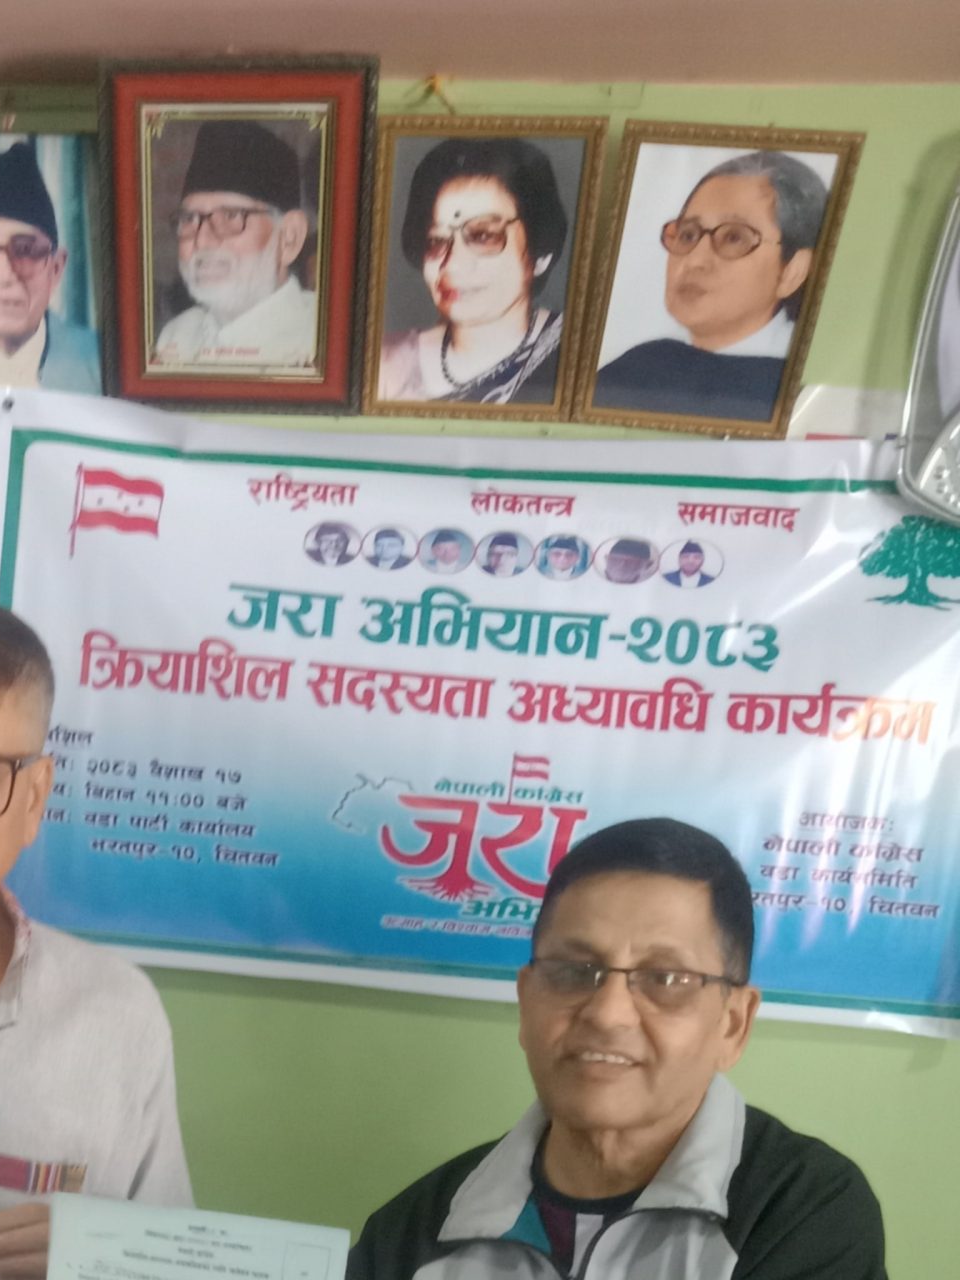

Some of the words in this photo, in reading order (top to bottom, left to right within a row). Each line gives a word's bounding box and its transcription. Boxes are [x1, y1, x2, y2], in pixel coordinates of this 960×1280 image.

[247, 471, 359, 511] राष्ट्रियता
[470, 486, 576, 517] लोकतन्त्र
[677, 501, 800, 532] समाजवाद
[226, 582, 344, 638] जरा
[358, 585, 781, 672] अभियान-२०८३
[78, 629, 295, 702] क्रियाशिल
[307, 661, 496, 720] सदस्यता
[506, 677, 715, 733] अध्यावधि
[725, 683, 936, 745] कार्यक्रम
[87, 758, 138, 779] २०८३
[215, 767, 242, 784] १७
[85, 780, 136, 802] बिहान
[216, 792, 248, 811] बजे
[434, 778, 505, 798] नेपाली
[84, 811, 119, 828] वडा
[178, 818, 256, 838] कार्यालय
[214, 843, 279, 867] चितवन
[380, 794, 588, 902] जरा
[762, 834, 841, 857] नेपाली
[759, 863, 800, 882] वडा
[869, 894, 940, 919] चितवन
